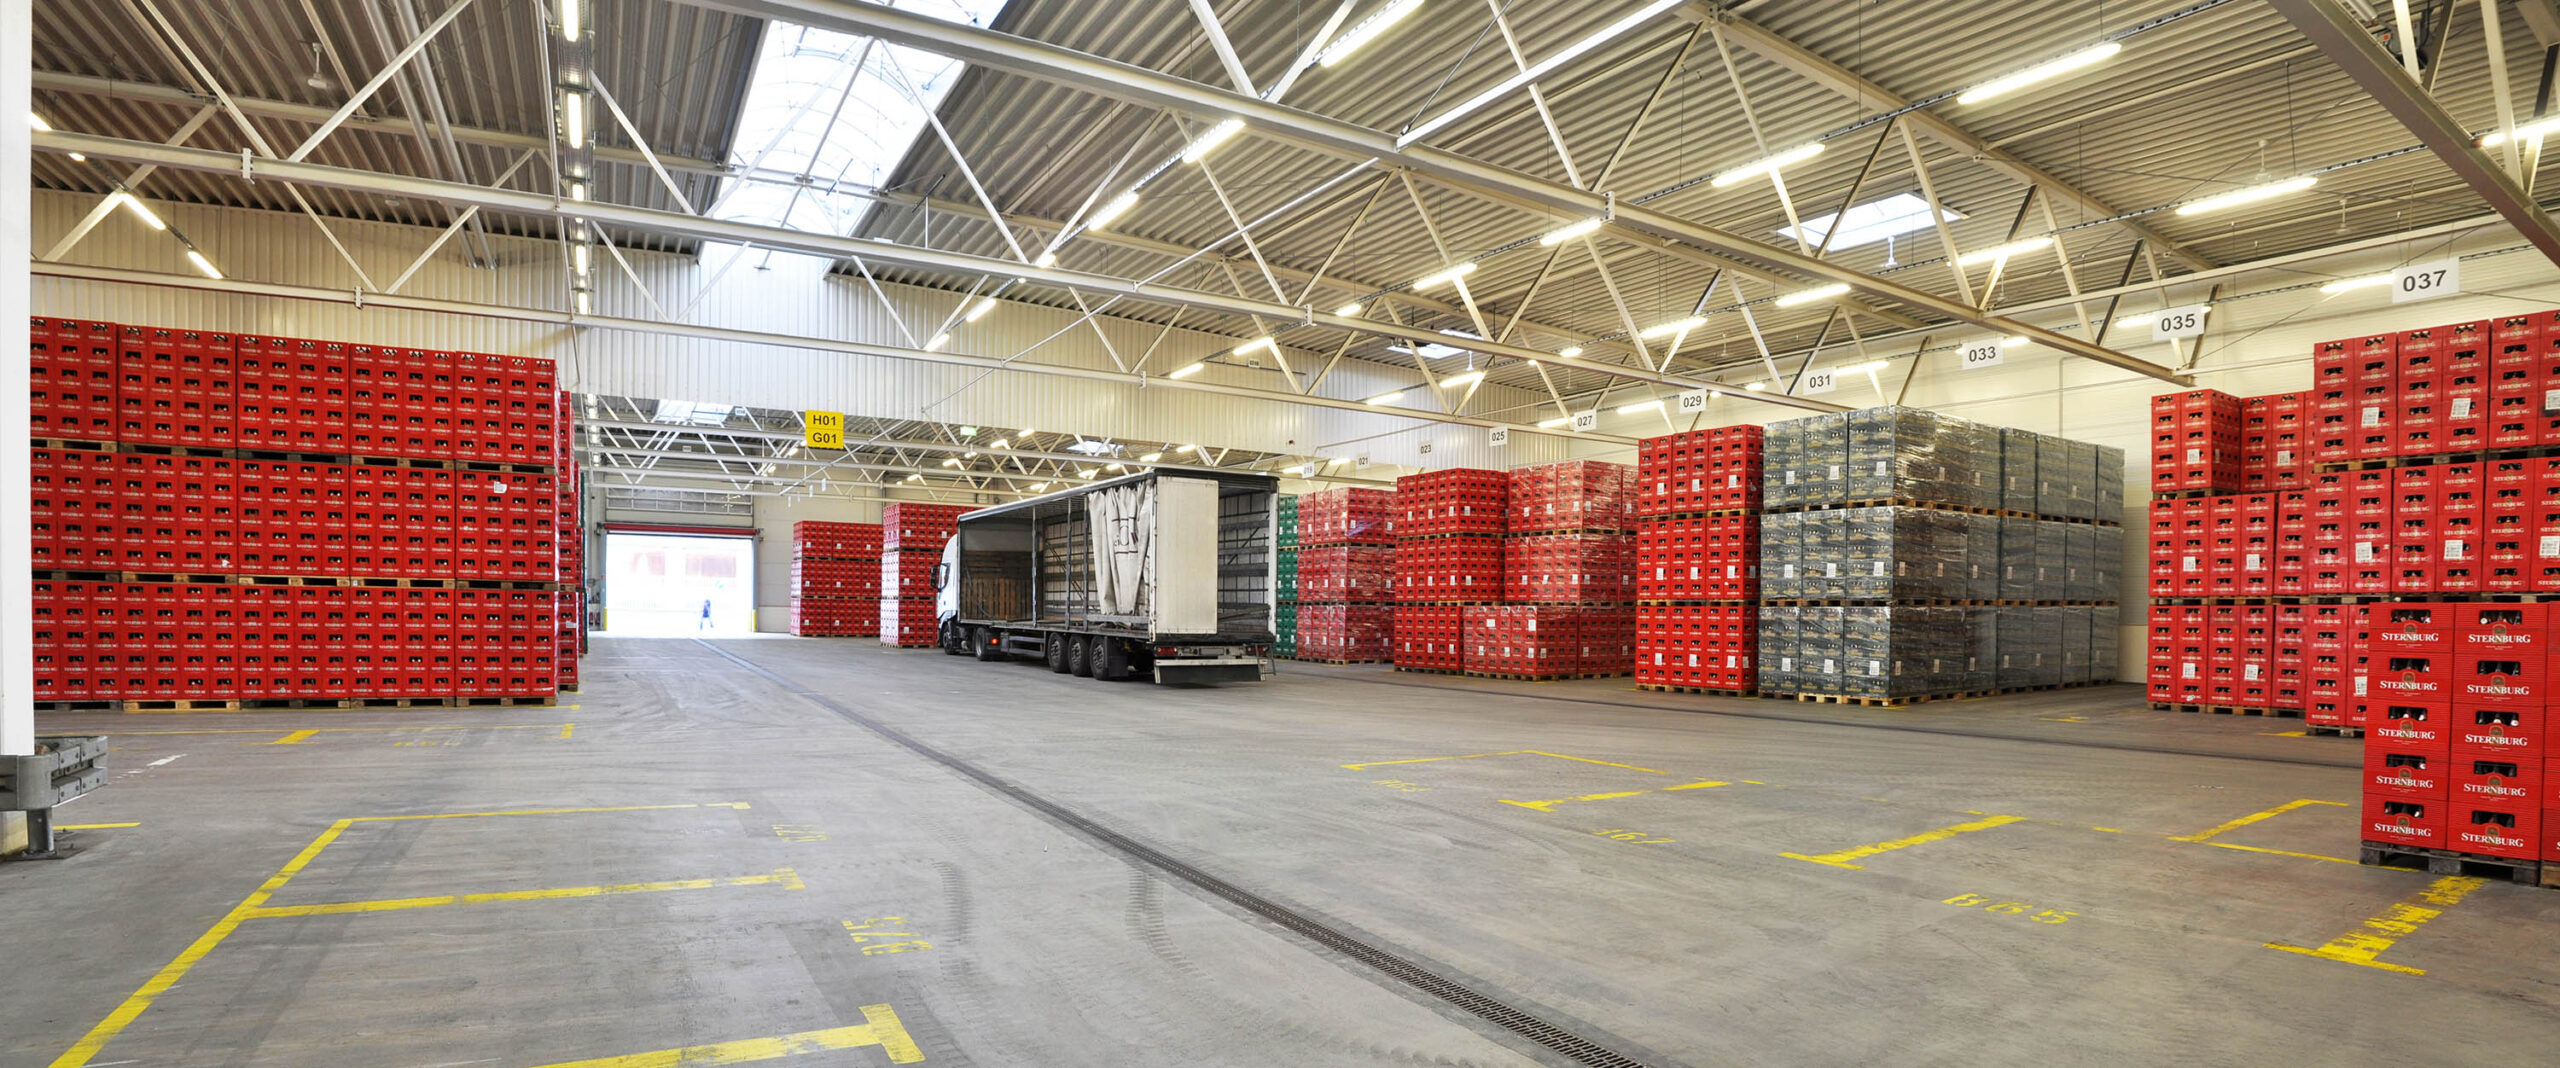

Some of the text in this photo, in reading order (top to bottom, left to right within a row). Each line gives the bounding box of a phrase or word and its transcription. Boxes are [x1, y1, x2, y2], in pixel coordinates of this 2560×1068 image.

[2403, 269, 2447, 293] 037
[2161, 313, 2195, 332] 035
[1969, 346, 1996, 363] 033
[1809, 374, 1832, 389] 031
[1683, 395, 1702, 408] 029
[812, 414, 837, 426] H01
[1578, 415, 1593, 427] 027
[812, 432, 837, 444] G01
[1491, 431, 1505, 442] 025
[1420, 444, 1432, 455] 023
[1358, 456, 1368, 466] 021
[2381, 632, 2439, 642] STERNBURG
[2468, 633, 2531, 644] STERNBURG
[2379, 680, 2438, 691] STERNBURG
[2467, 684, 2530, 695] STERNBURG
[2378, 727, 2435, 740] STERNBURG
[2465, 734, 2528, 746] STERNBURG
[2376, 775, 2433, 788] STERNBURG
[2463, 783, 2526, 797] STERNBURG
[2374, 823, 2431, 837] STERNBURG
[2461, 832, 2524, 848] STERNBURG
